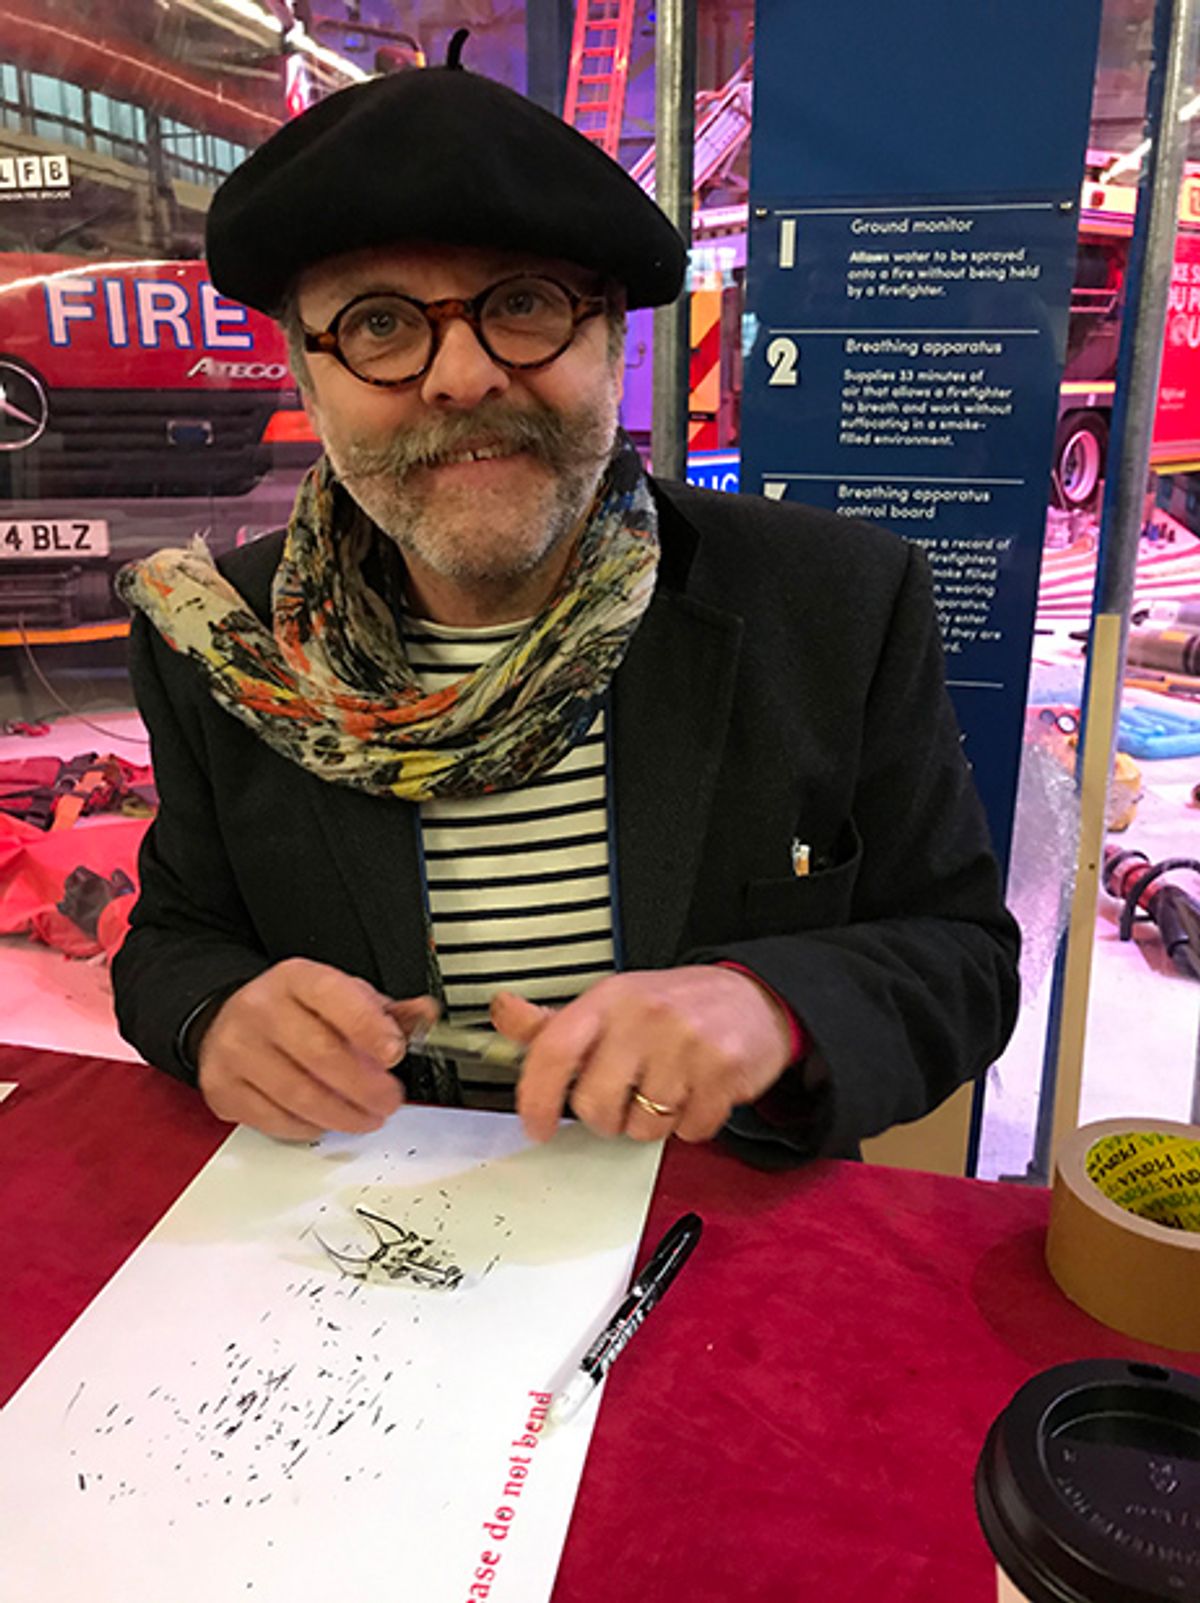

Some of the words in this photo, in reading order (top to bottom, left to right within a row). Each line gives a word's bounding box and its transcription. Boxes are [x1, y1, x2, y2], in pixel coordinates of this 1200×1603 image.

[851, 218, 909, 234] Ground
[912, 216, 974, 232] monitor
[779, 219, 796, 268] 1
[849, 251, 890, 263] Allows
[893, 251, 931, 262] water
[933, 251, 947, 262] to
[951, 249, 968, 262] be
[970, 247, 1026, 264] sprayed
[847, 268, 877, 280] onto
[879, 270, 889, 280] a
[891, 266, 914, 280] fire
[917, 267, 966, 280] without
[968, 265, 1007, 282] being
[1008, 265, 1041, 280] held
[847, 284, 863, 300] by
[865, 286, 875, 297] a
[878, 283, 946, 300] firefighter.
[44, 276, 254, 349] FIRE
[845, 338, 919, 357] Breathing
[922, 341, 1003, 357] apparatus
[766, 337, 799, 386] 2
[844, 369, 896, 384] Supplies
[917, 370, 966, 382] minutes
[969, 369, 985, 382] of
[842, 387, 860, 398] air
[863, 386, 890, 398] that
[891, 386, 931, 398] allows
[934, 388, 944, 398] a
[946, 386, 1013, 401] firefighter
[841, 402, 855, 413] to
[857, 402, 899, 414] breath
[902, 402, 927, 414] and
[930, 402, 960, 414] work
[964, 402, 1013, 415] without
[841, 416, 910, 432] suffocating
[912, 418, 925, 430] in
[927, 420, 937, 430] a
[940, 418, 987, 430] smoke-
[839, 432, 872, 445] filled
[874, 432, 955, 446] environment.
[838, 483, 910, 503] Breathing
[912, 488, 990, 503] apparatus
[836, 504, 887, 518] control
[891, 504, 936, 519] board
[32, 524, 92, 551] BLZ
[941, 539, 949, 549] a
[951, 538, 994, 550] record
[995, 538, 1012, 551] of
[927, 551, 996, 567] firefighters
[965, 568, 997, 580] filled
[945, 583, 996, 598] wearing
[954, 614, 987, 624] enter
[951, 627, 977, 642] they
[980, 630, 1001, 640] are
[511, 1390, 554, 1448] bend
[503, 1456, 532, 1497] not
[482, 1505, 516, 1540] do
